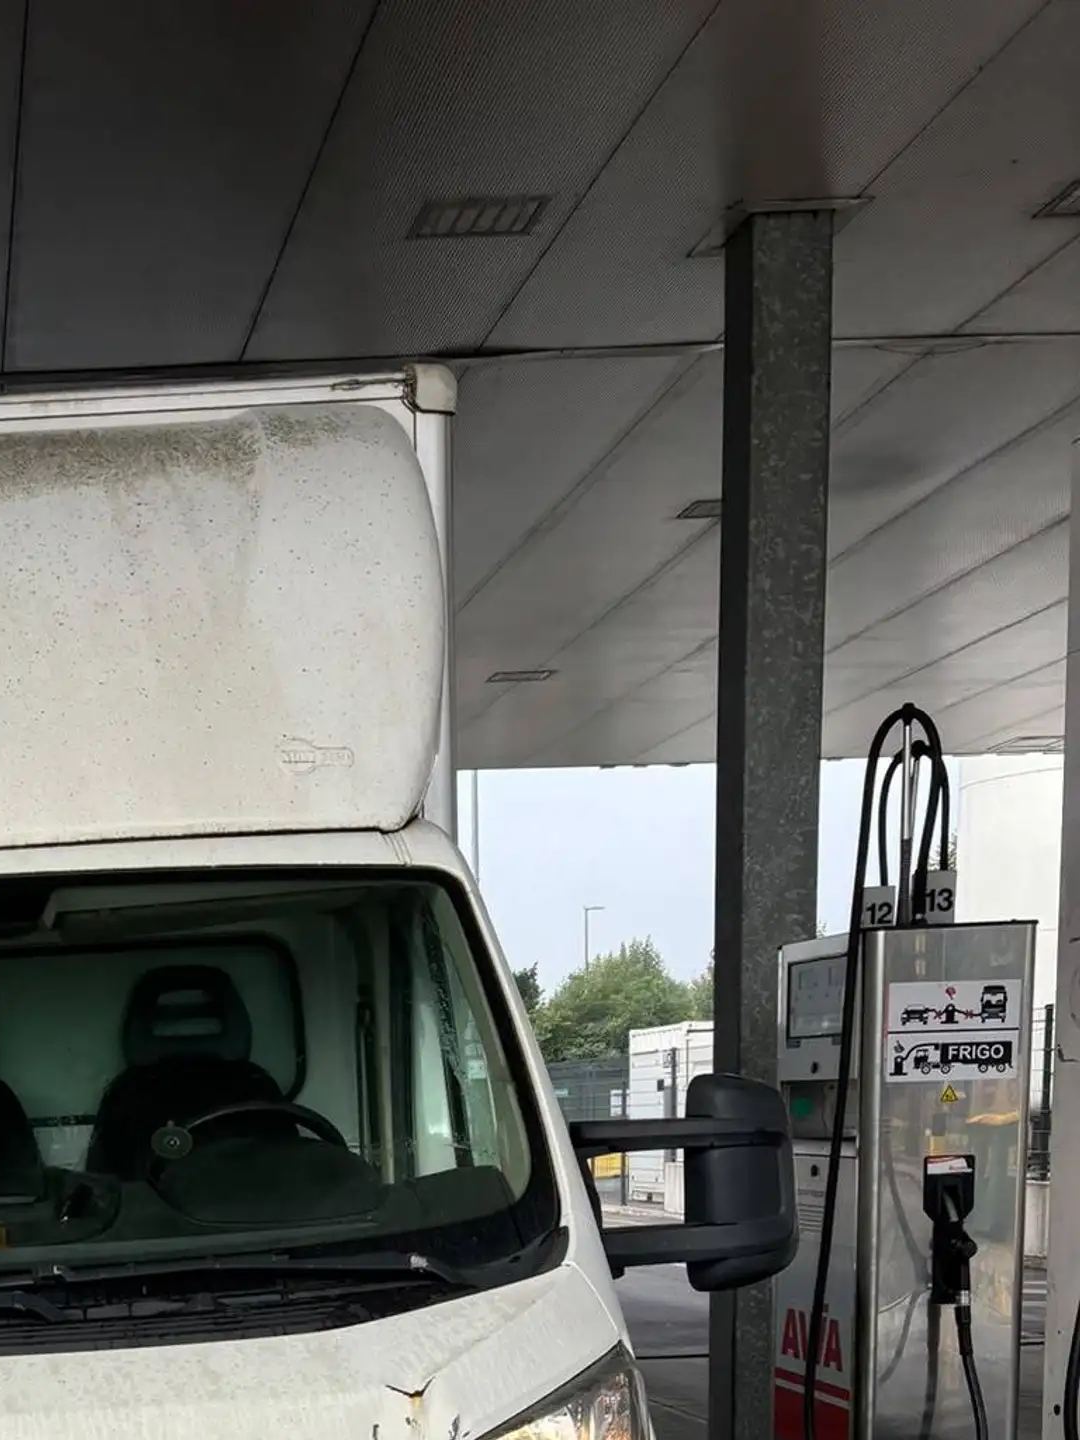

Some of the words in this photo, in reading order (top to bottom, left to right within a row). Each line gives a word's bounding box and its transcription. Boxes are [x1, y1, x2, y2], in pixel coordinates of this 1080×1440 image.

[924, 887, 954, 913] 13
[865, 902, 893, 925] 12
[947, 1044, 1005, 1061] FRIGO
